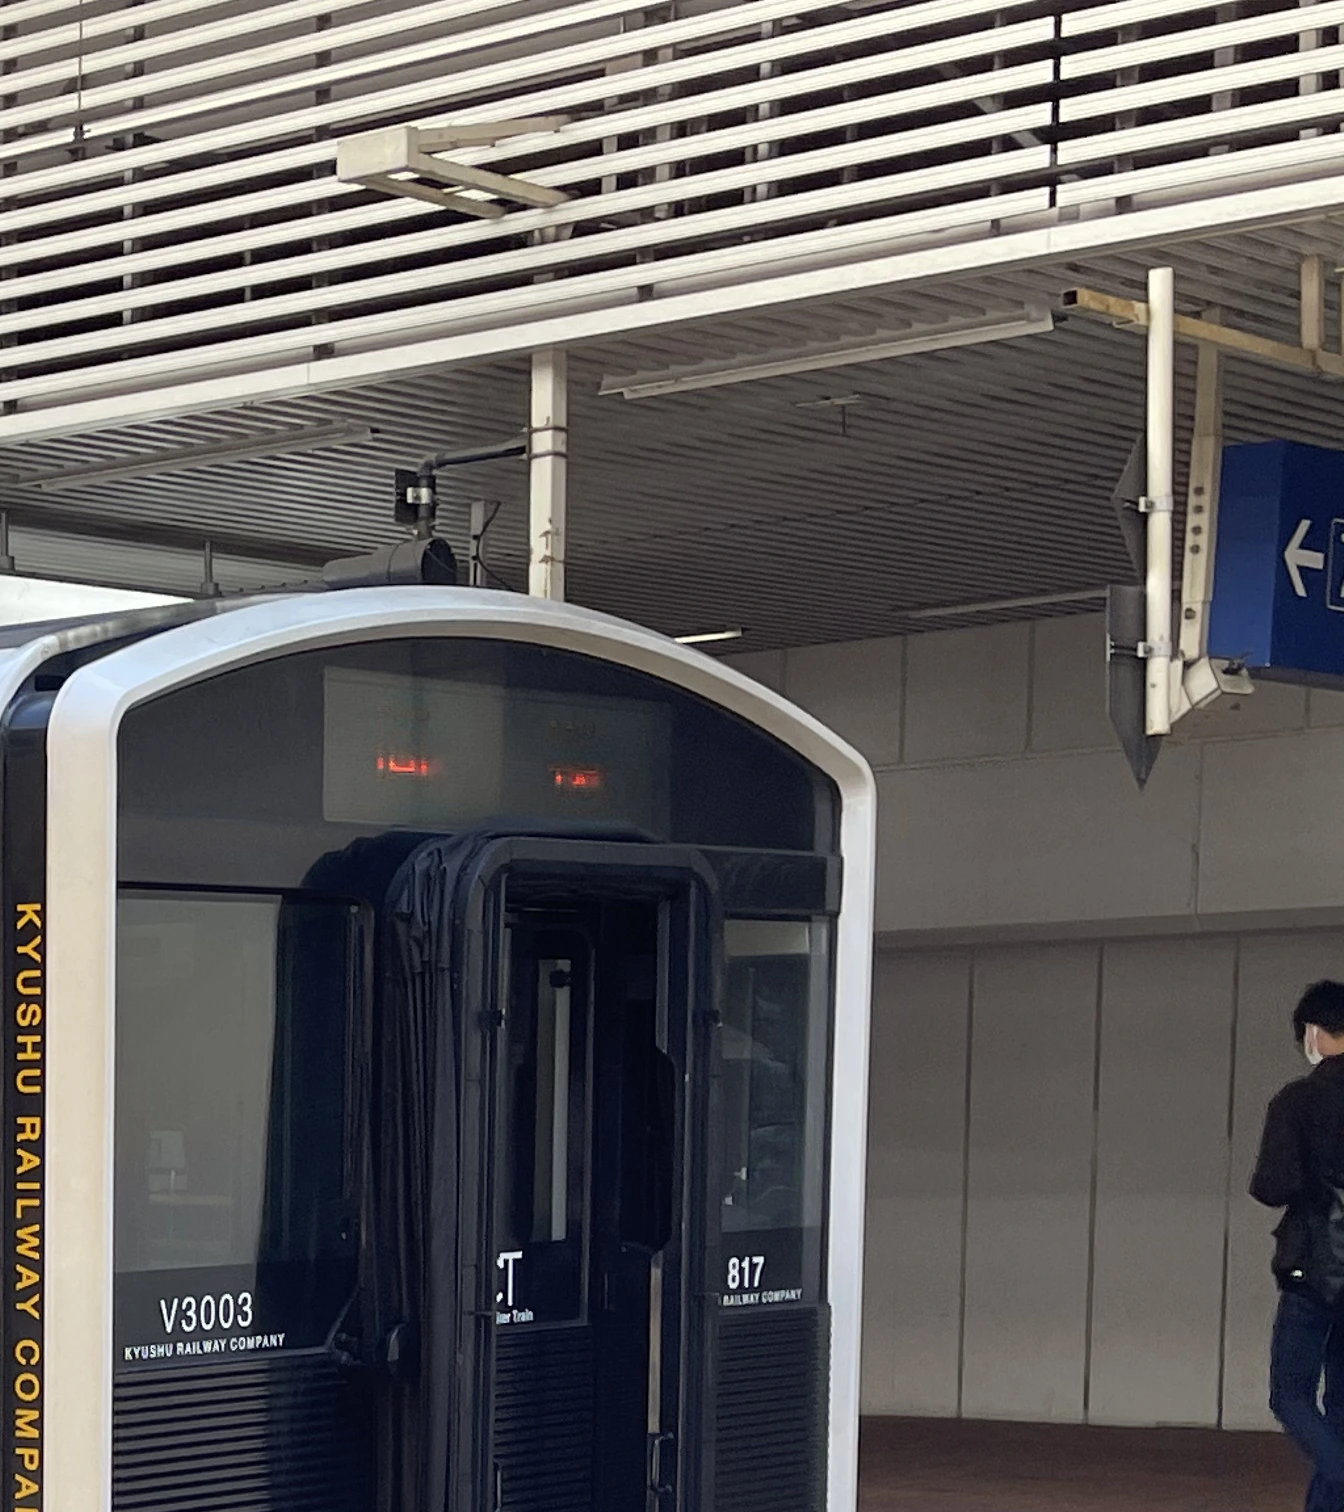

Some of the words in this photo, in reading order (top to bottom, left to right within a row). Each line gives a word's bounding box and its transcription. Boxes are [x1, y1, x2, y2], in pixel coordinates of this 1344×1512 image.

[15, 903, 43, 1095] KYUSHU
[15, 1116, 42, 1321] RAILWAY
[727, 1255, 765, 1290] 817
[160, 1291, 253, 1334] V3003
[722, 1293, 760, 1307] RAILWAY
[761, 1288, 803, 1304] COMPANY
[124, 1343, 174, 1361] KYUSHU
[176, 1339, 228, 1356] RAILWAY
[230, 1333, 286, 1351] COMPANY
